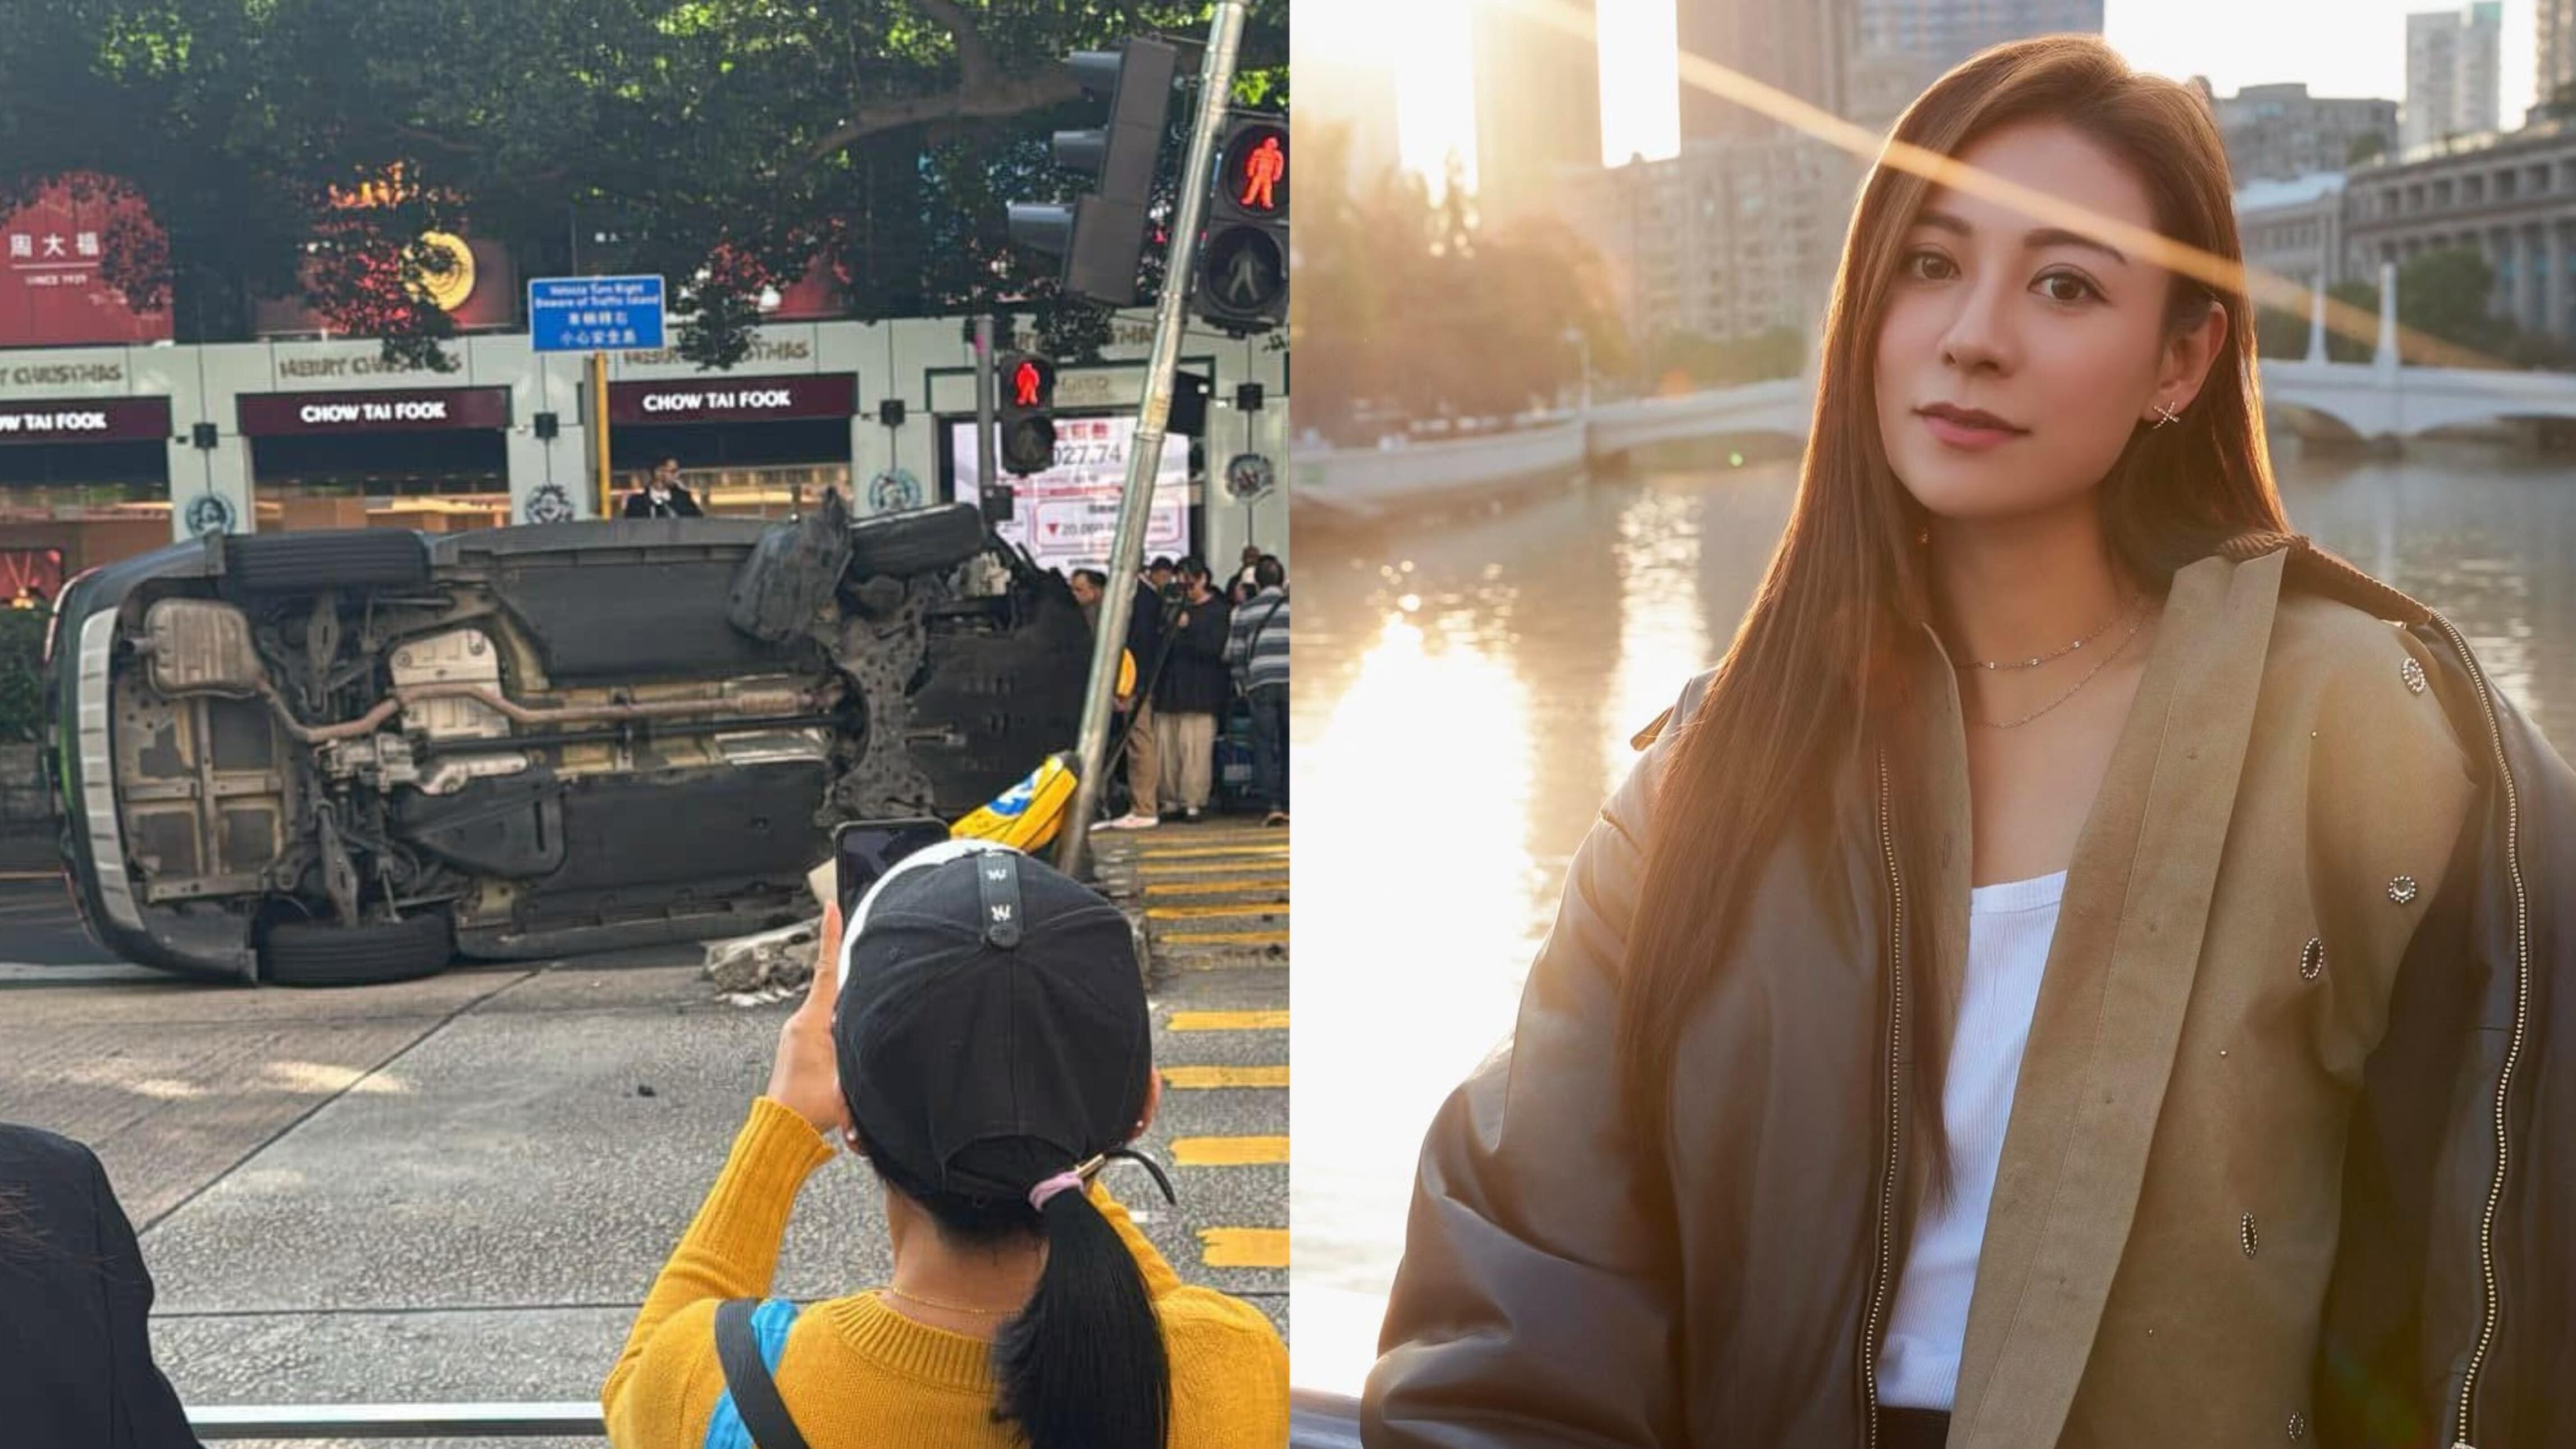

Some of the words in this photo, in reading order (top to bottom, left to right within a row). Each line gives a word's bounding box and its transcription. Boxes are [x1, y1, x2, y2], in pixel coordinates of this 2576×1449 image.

[10, 232, 99, 257] 周大福
[643, 394, 702, 411] CHOW
[706, 392, 735, 408] TAI
[739, 390, 792, 408] FOOK
[24, 414, 53, 430] TAI
[57, 412, 106, 429] FOOK
[300, 405, 359, 422] CHOW
[362, 404, 391, 419] TAI
[395, 401, 447, 419] FOOK
